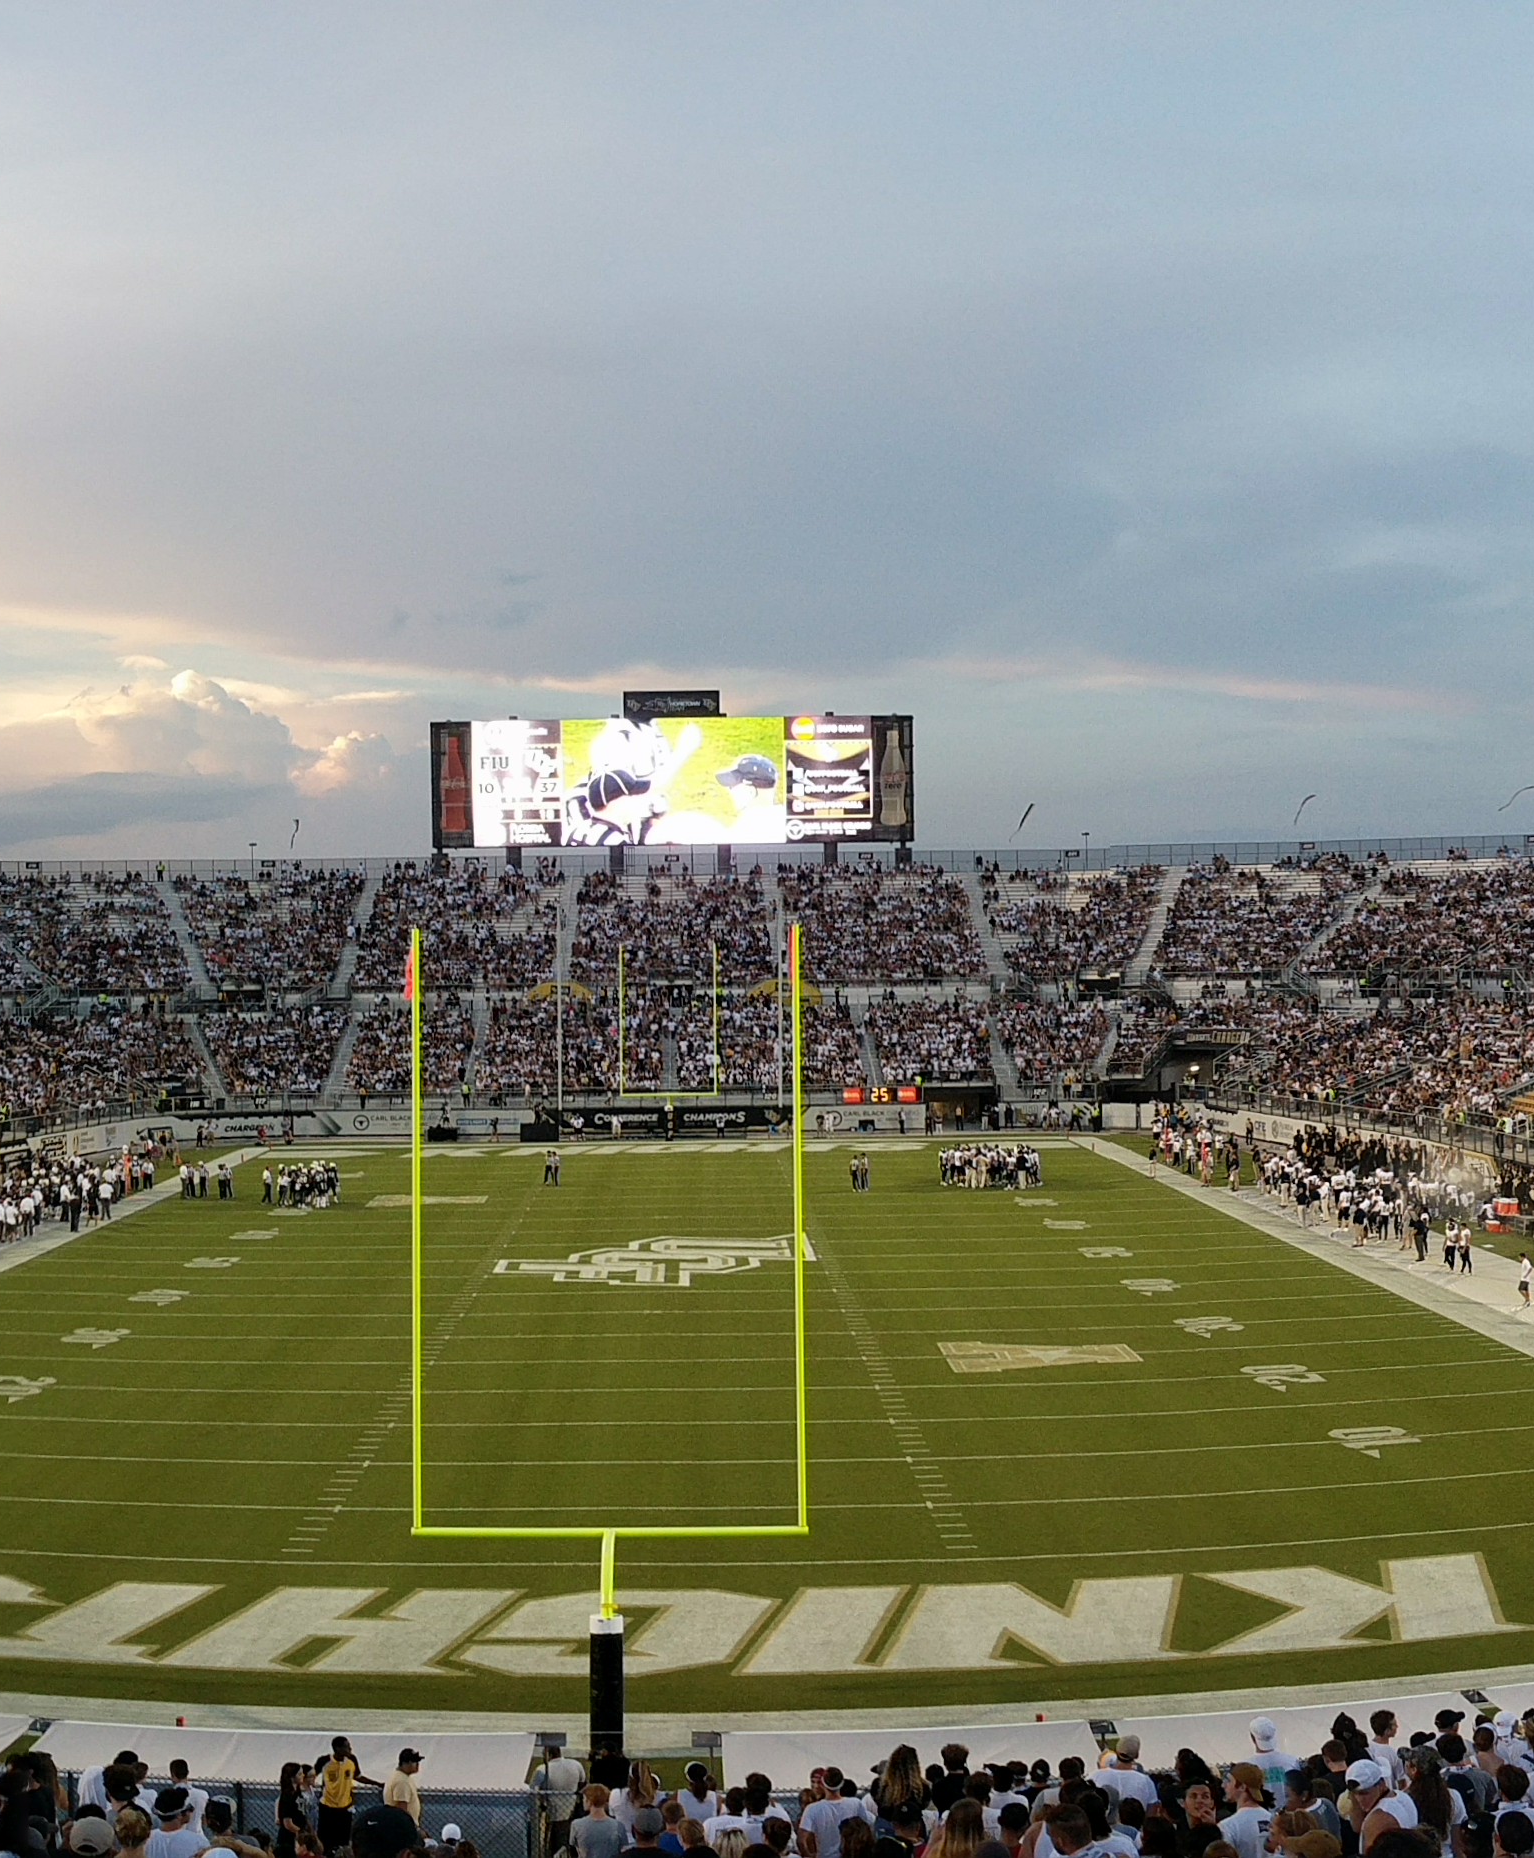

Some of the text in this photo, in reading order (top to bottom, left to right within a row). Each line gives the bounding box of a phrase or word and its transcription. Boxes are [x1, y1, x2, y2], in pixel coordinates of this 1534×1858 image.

[480, 756, 510, 770] FIU
[479, 783, 495, 794] 10
[540, 782, 558, 793] 37
[885, 782, 902, 790] zero
[870, 1087, 889, 1102] 25
[1239, 1363, 1328, 1385] 20
[1327, 1425, 1423, 1450] 10
